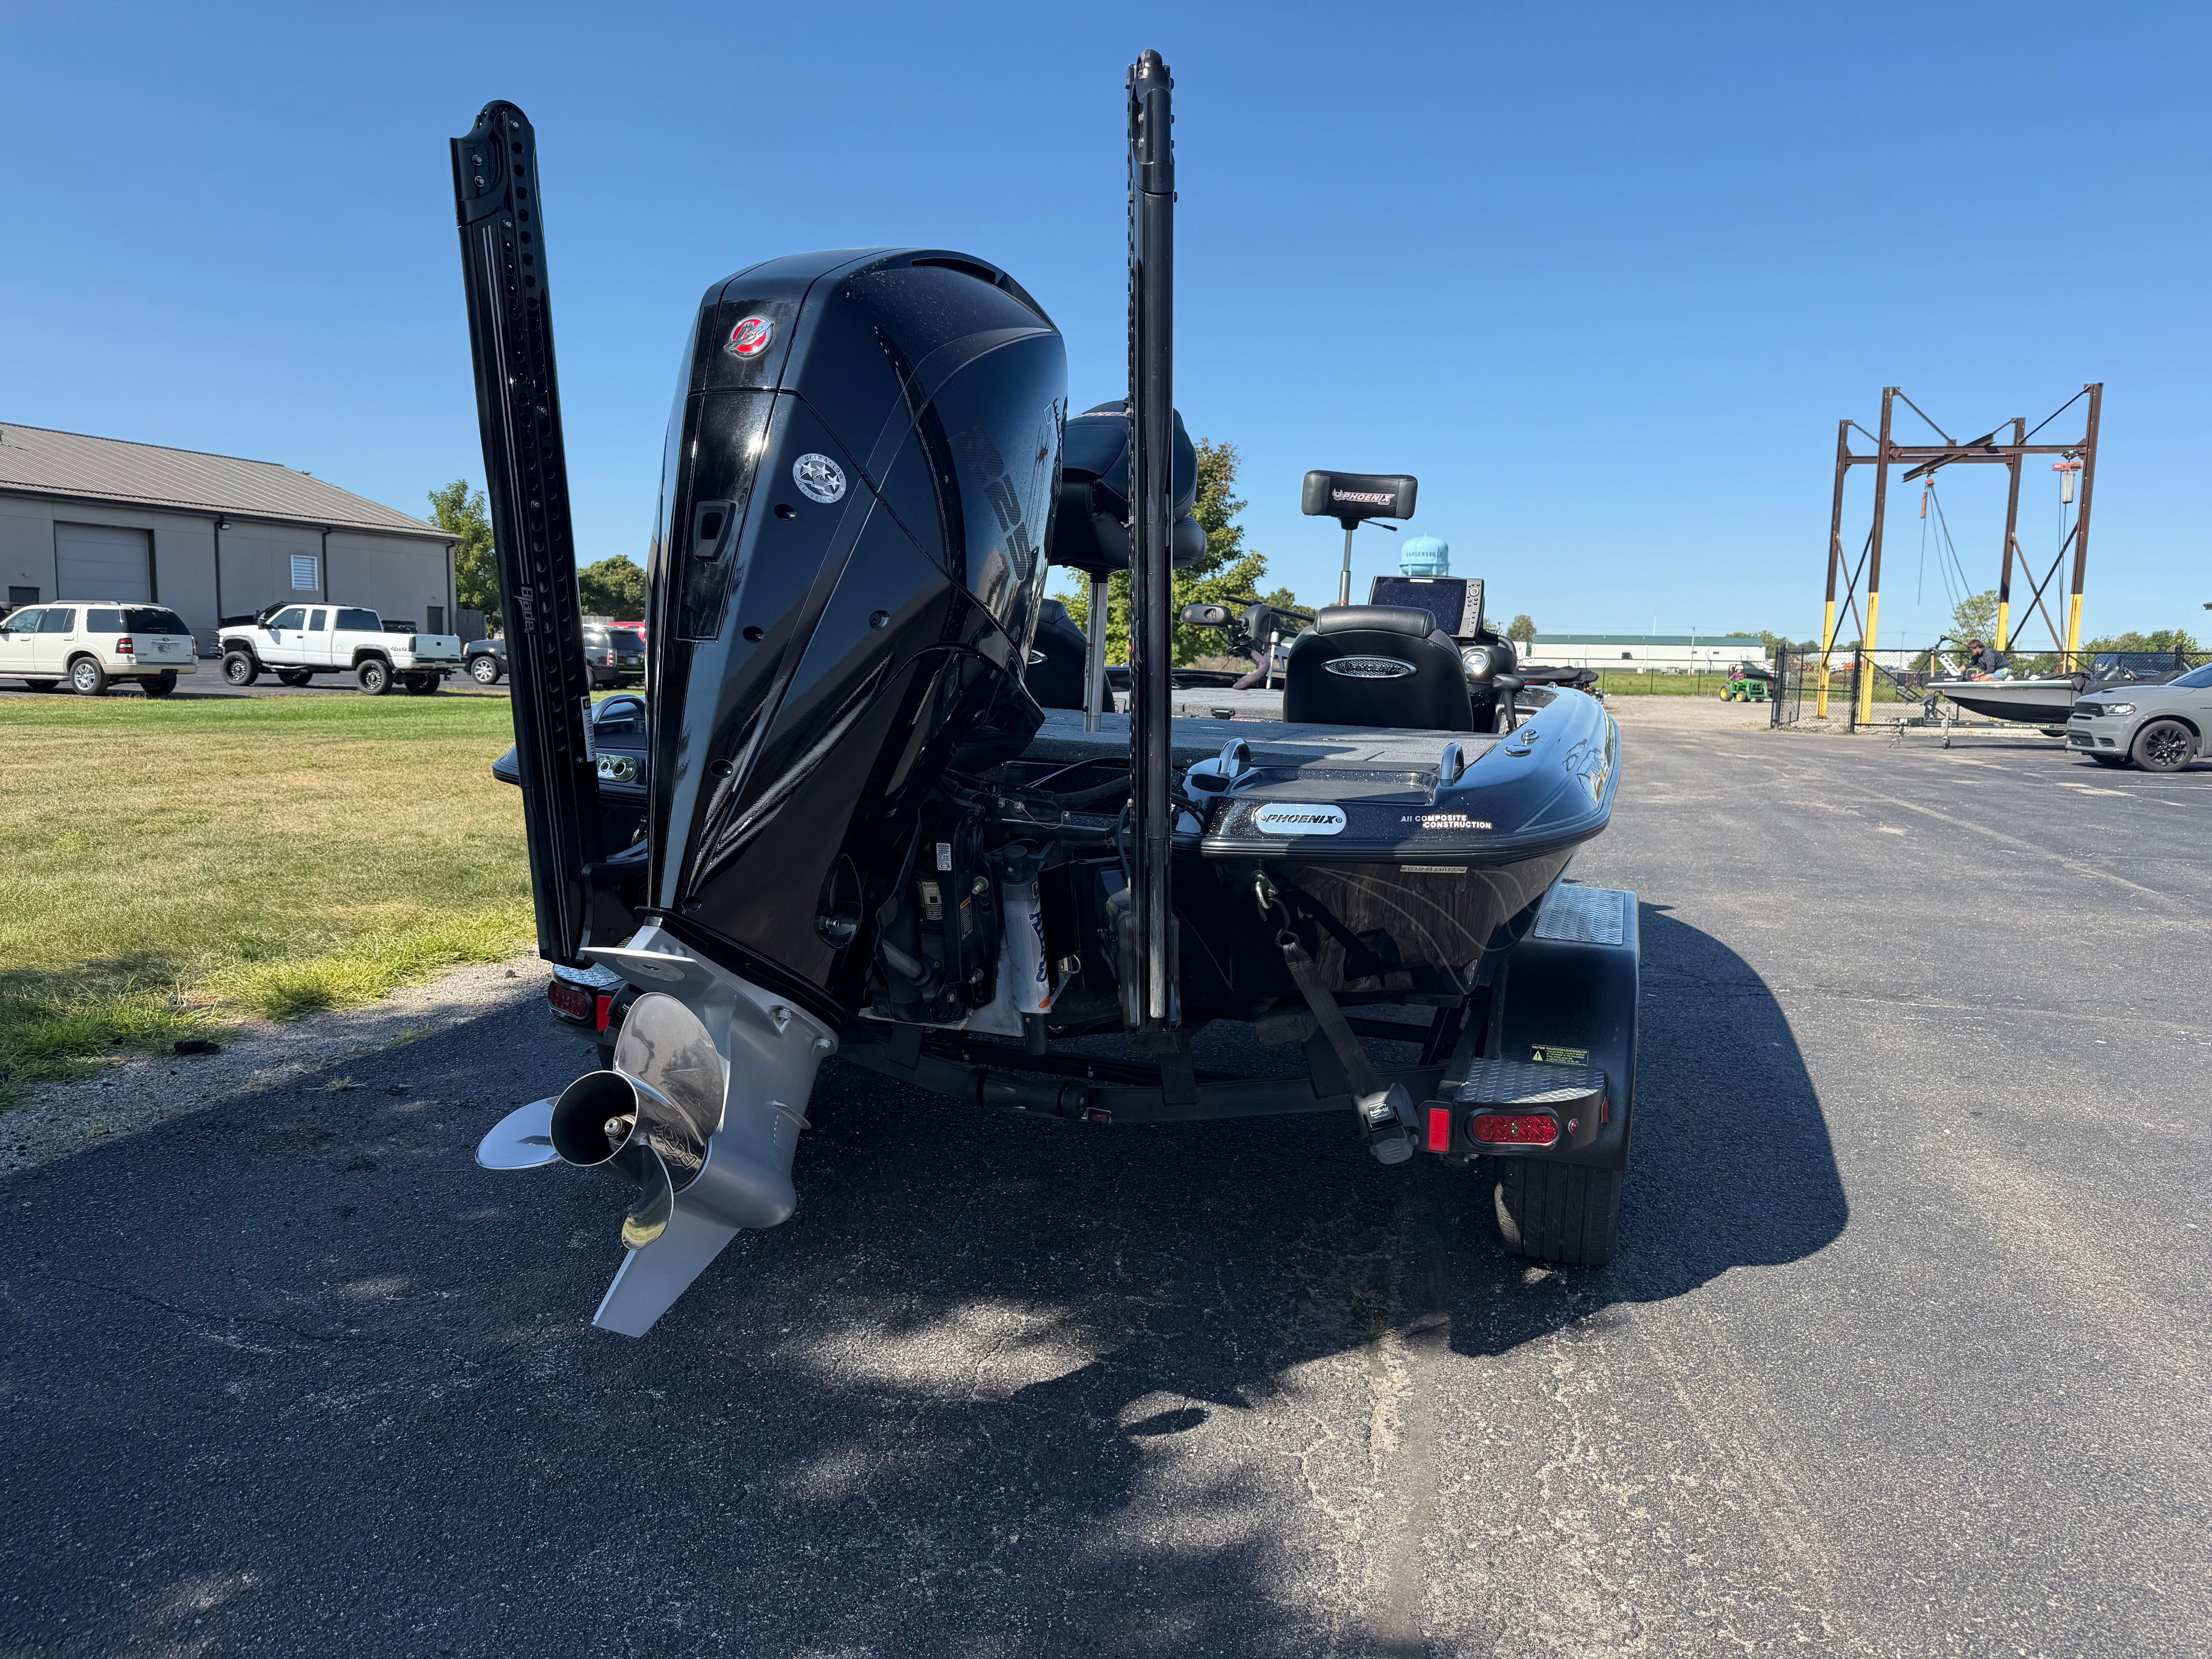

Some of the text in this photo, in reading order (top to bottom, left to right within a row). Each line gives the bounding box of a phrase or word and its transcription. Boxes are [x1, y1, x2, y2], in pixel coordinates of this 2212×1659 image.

[804, 454, 828, 463] ULTRA
[832, 464, 844, 479] LOW
[1342, 491, 1392, 502] PHOENIX
[1350, 663, 1399, 673] PHOENIX
[1266, 815, 1337, 824] PHOENIX
